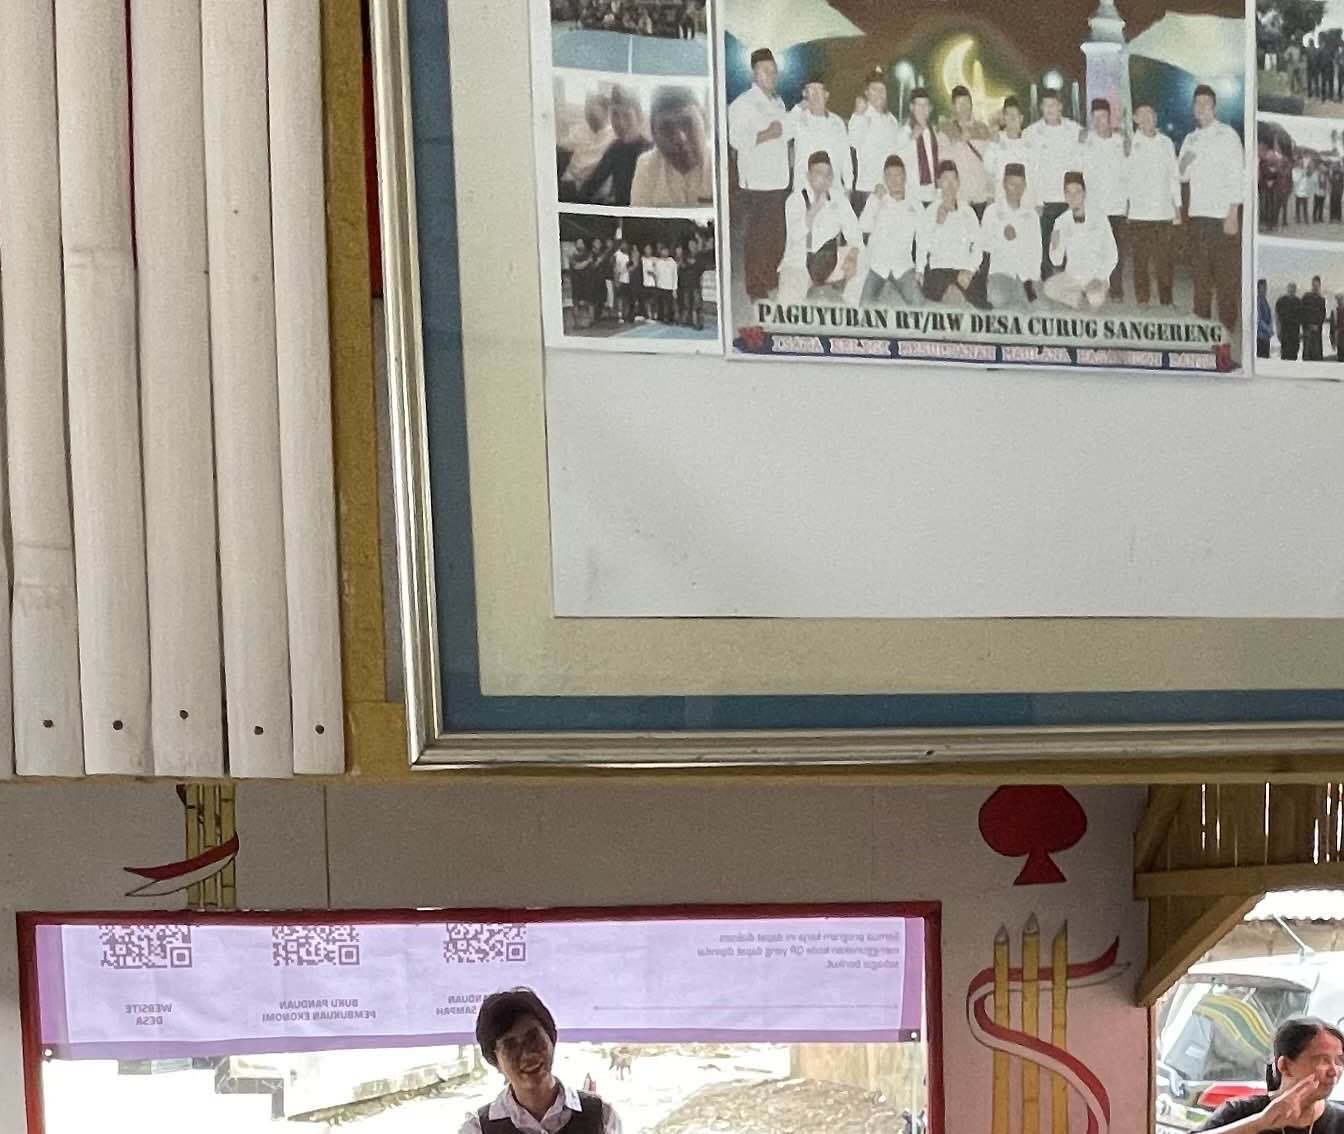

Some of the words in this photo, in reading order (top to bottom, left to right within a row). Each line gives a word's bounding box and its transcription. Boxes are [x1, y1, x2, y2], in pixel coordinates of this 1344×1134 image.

[757, 304, 888, 329] PAGUYUBAN
[896, 311, 962, 334] RT/RW
[970, 315, 1021, 336] DESA
[1027, 317, 1097, 339] CURUG
[1103, 321, 1221, 343] SANGERENG
